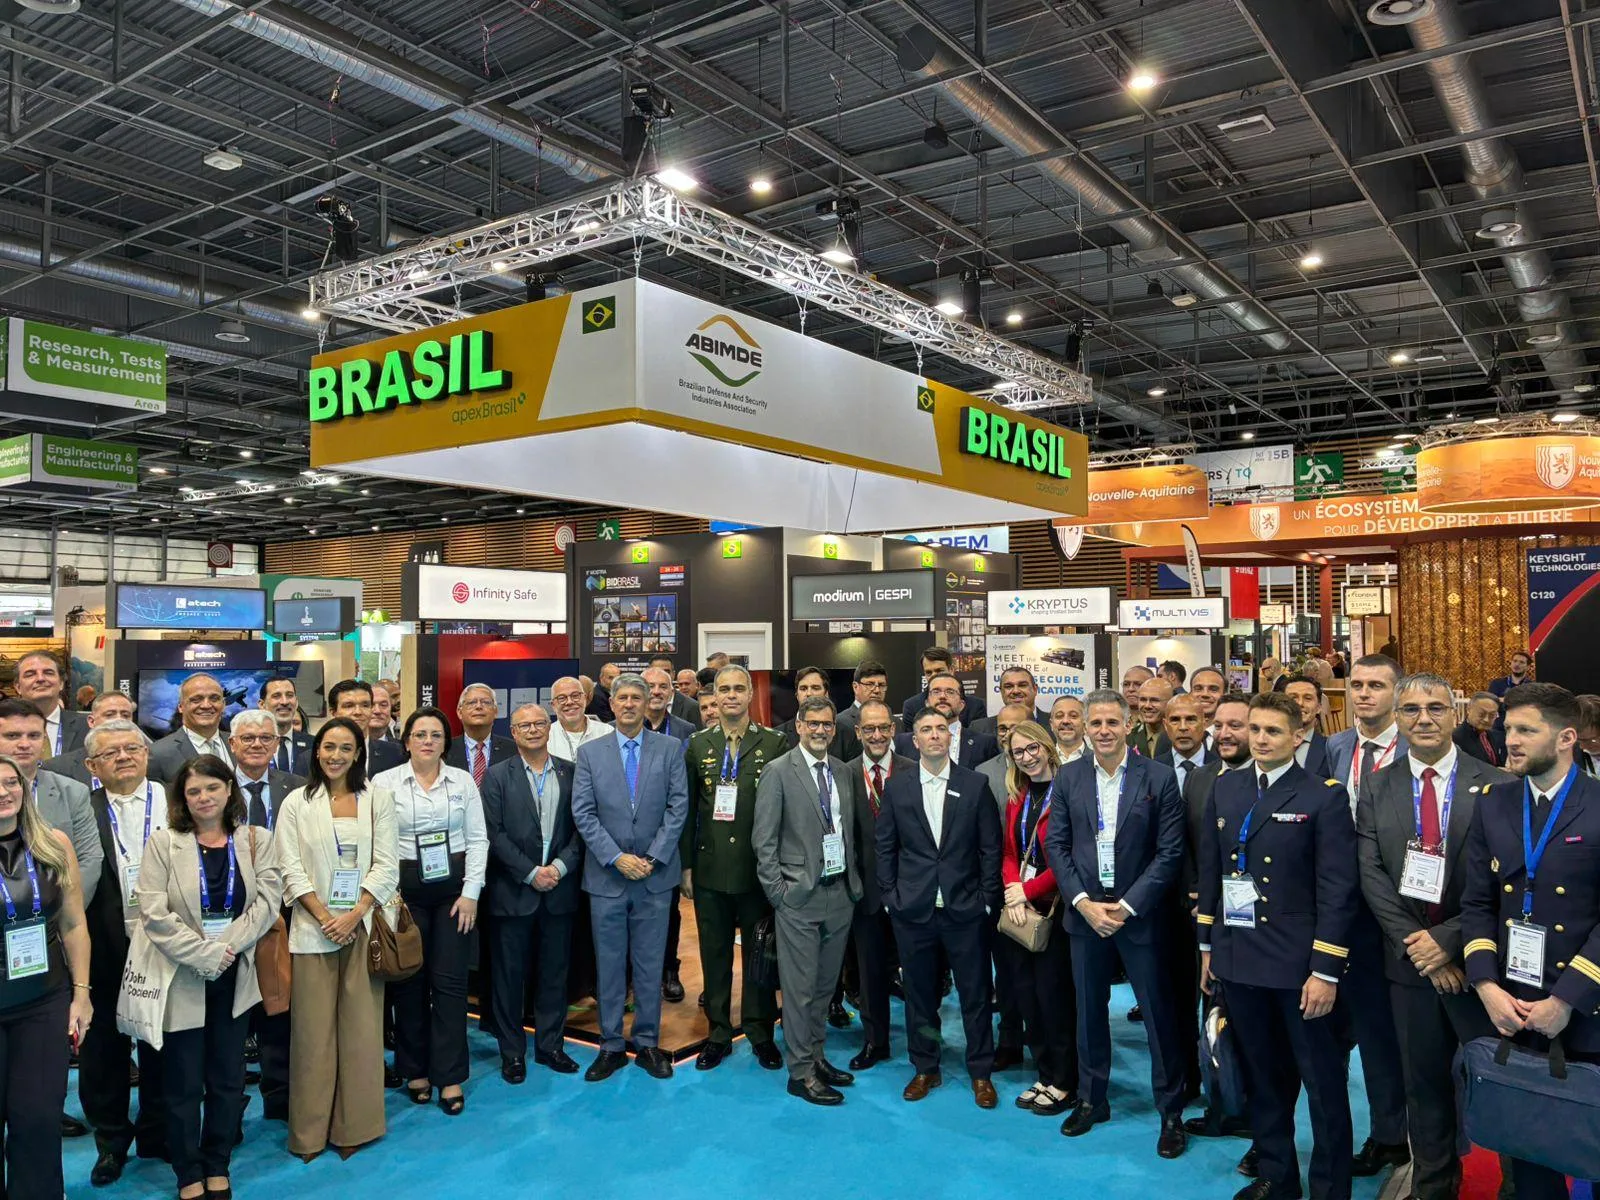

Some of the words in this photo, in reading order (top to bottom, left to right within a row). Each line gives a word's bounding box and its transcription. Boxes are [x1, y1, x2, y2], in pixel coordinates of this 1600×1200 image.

[29, 335, 114, 364] Research,
[120, 351, 162, 370] Tests
[685, 333, 762, 368] ABIMDE
[28, 351, 40, 365] &
[47, 354, 162, 385] Measurement
[310, 330, 504, 421] BRASIL
[678, 379, 706, 393] Brazilian
[707, 386, 731, 399] Defense
[732, 393, 744, 403] And
[745, 396, 768, 409] Security
[134, 399, 160, 411] Area
[452, 398, 517, 425] apexBrasil
[692, 393, 721, 407] Industries
[722, 401, 757, 415] Association
[968, 407, 1072, 478] BRASIL
[47, 444, 121, 464] Engineering
[125, 452, 133, 463] &
[46, 455, 134, 474] Manufacturing
[1088, 485, 1195, 502] Nouvelle-Aquitaine
[1293, 509, 1311, 520] UN
[1315, 496, 1419, 519] ÉCOSYSTÈM
[1324, 524, 1360, 536] POUR
[1364, 514, 1480, 534] DÉVELOPPER
[1529, 553, 1587, 563] KEYSIGHT
[1529, 563, 1600, 572] TECHNOLOGIES
[606, 576, 641, 586] BIDBRASIL
[473, 587, 511, 602] Infinity
[513, 589, 538, 600] Safe
[813, 589, 864, 603] modirum
[875, 588, 912, 600] GESPI
[1027, 598, 1088, 609] KRYPTUS
[1530, 591, 1555, 599] C120
[1189, 608, 1209, 616] VIS
[993, 654, 1025, 662] MEET
[993, 664, 1040, 672] FUTURE
[119, 679, 130, 697] ECH
[1034, 675, 1080, 683] SECURE
[1099, 668, 1108, 690] YPTUS
[422, 684, 433, 707] SAFE
